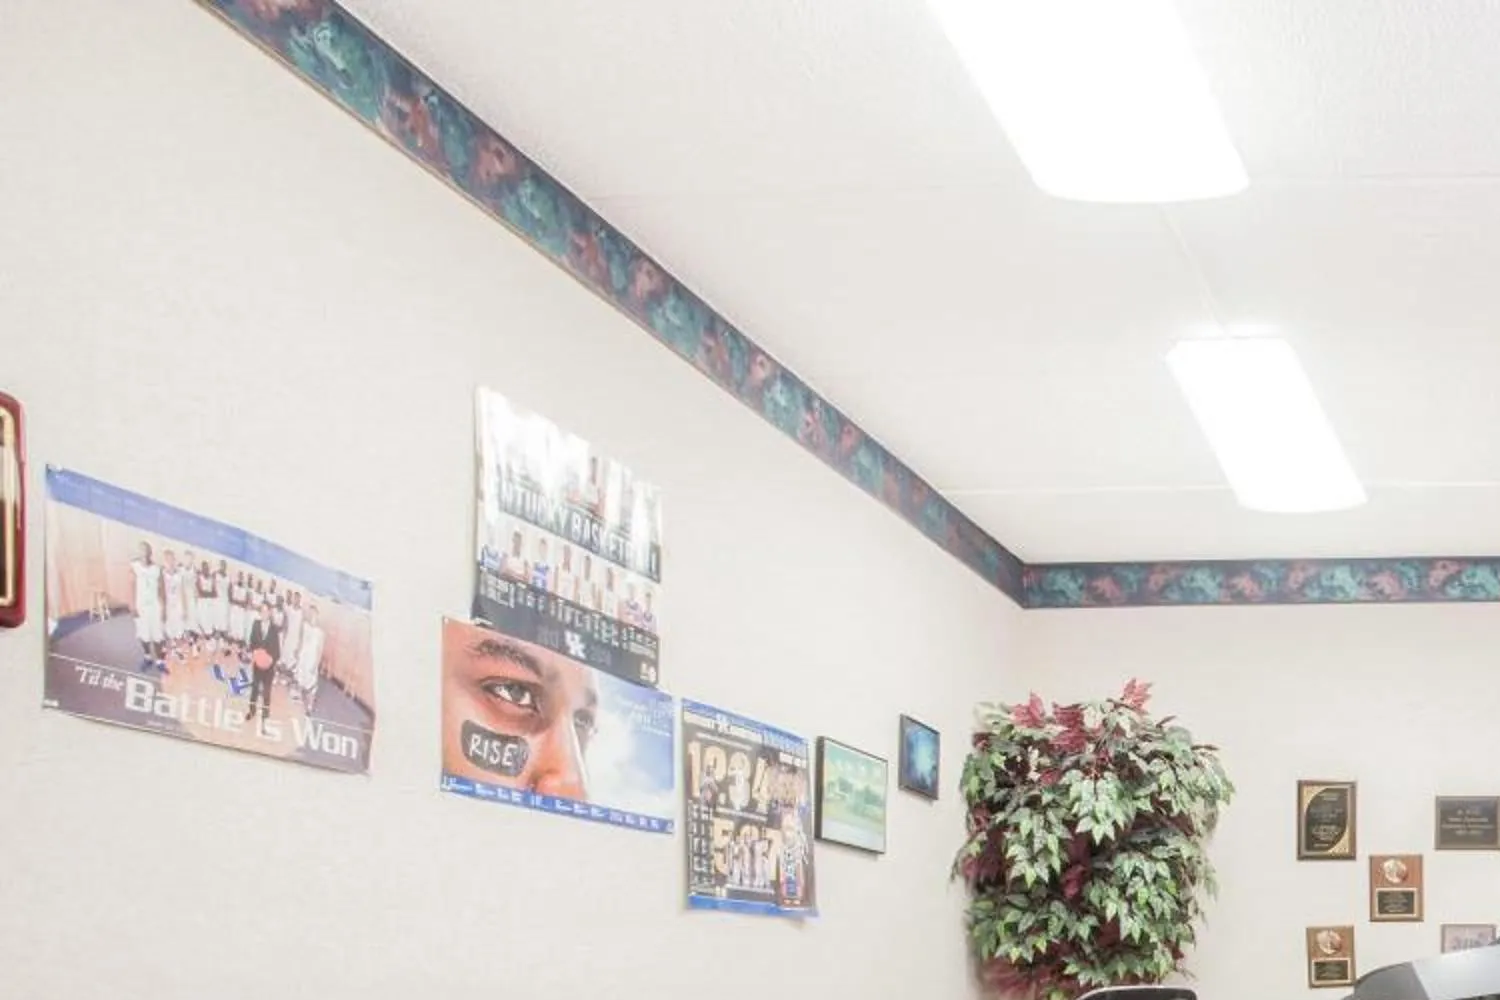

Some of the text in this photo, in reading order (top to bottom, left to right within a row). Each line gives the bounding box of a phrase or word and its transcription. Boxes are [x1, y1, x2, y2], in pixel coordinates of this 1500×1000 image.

[124, 675, 245, 733] Battle
[289, 717, 359, 760] Won
[468, 733, 518, 767] RISE
